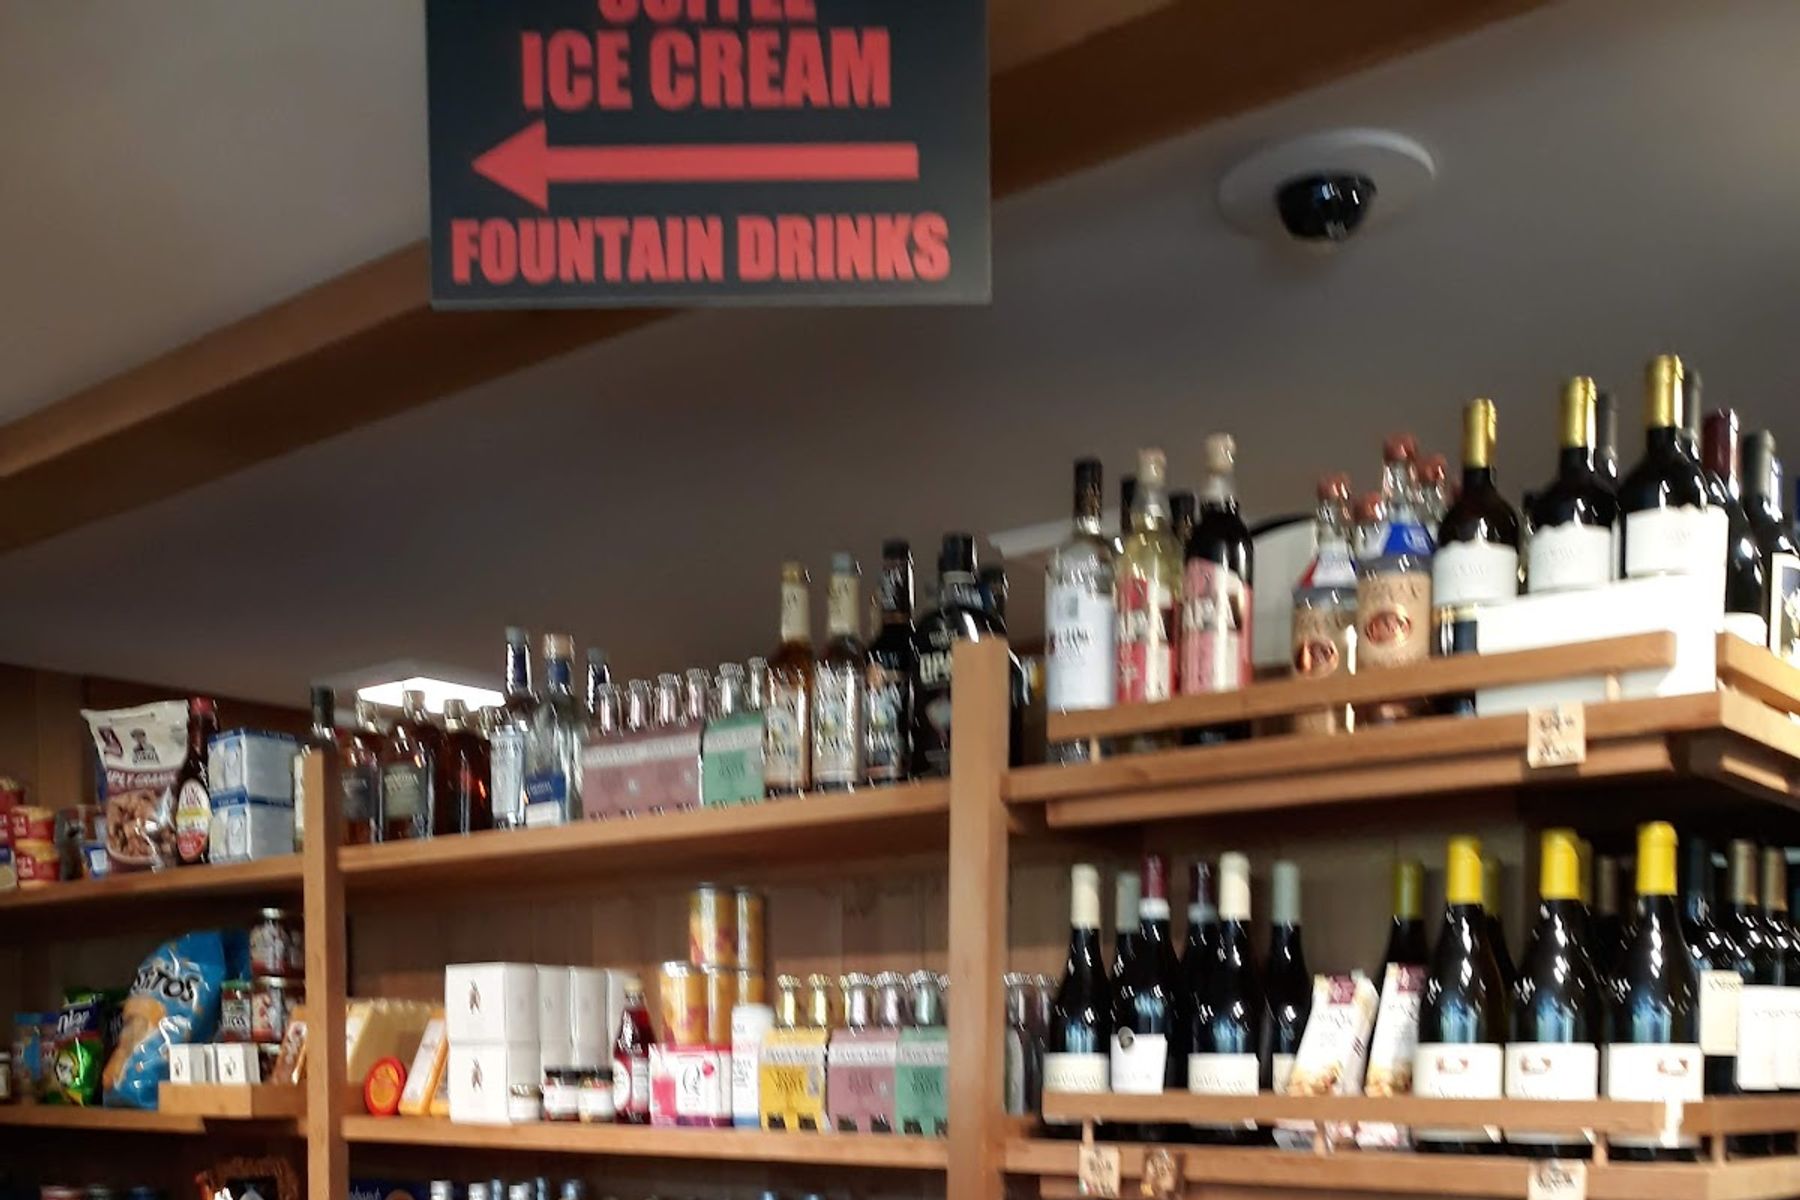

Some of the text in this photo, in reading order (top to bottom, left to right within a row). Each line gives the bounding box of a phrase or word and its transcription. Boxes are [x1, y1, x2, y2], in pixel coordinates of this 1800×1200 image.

[521, 26, 893, 111] ICE CREAM
[450, 211, 951, 285] FOUNTAIN DRINKS
